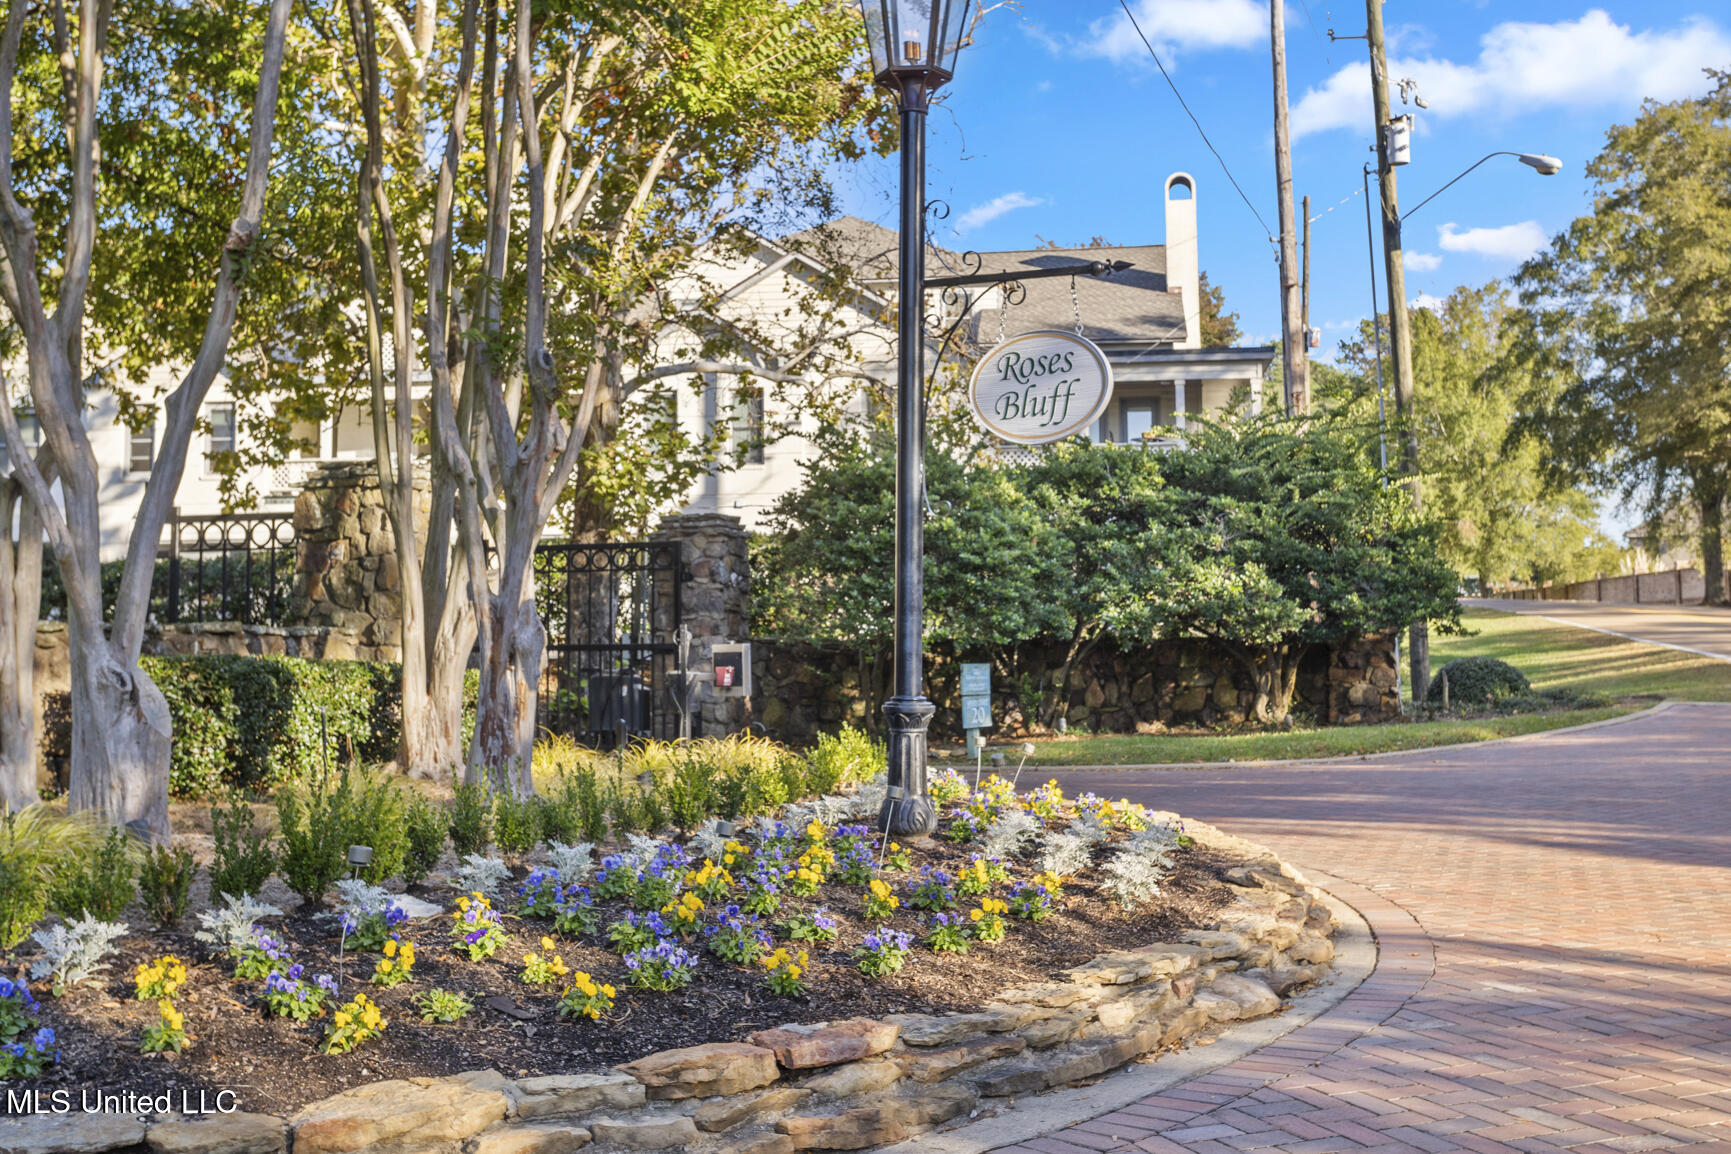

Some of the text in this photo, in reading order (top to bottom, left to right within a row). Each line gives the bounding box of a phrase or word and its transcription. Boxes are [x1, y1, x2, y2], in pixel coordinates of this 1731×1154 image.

[998, 351, 1074, 385] Roses
[995, 378, 1081, 427] Bluff
[971, 707, 986, 724] 20
